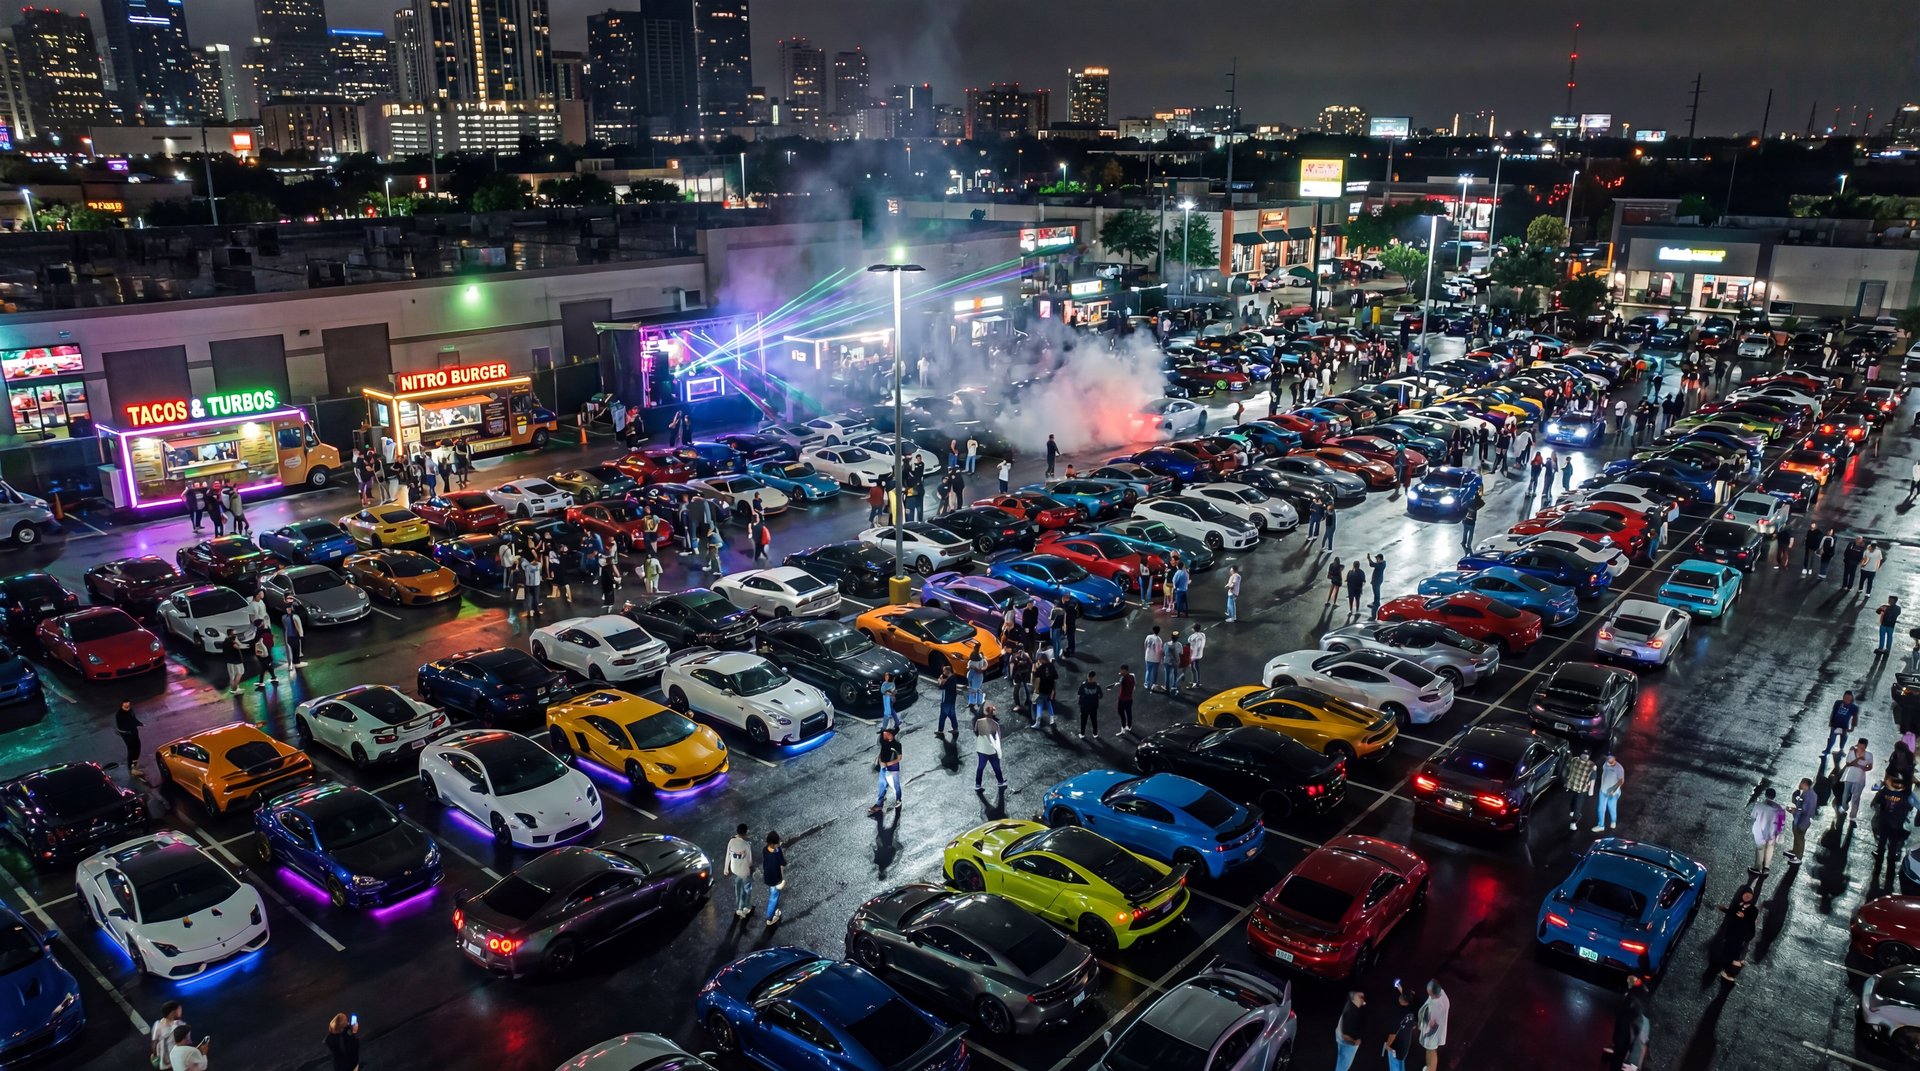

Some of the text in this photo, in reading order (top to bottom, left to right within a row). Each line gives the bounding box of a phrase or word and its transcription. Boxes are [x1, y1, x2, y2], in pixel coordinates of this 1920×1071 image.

[401, 363, 507, 391] NITRO BURGER
[127, 390, 275, 426] TACOS & TURBOS
